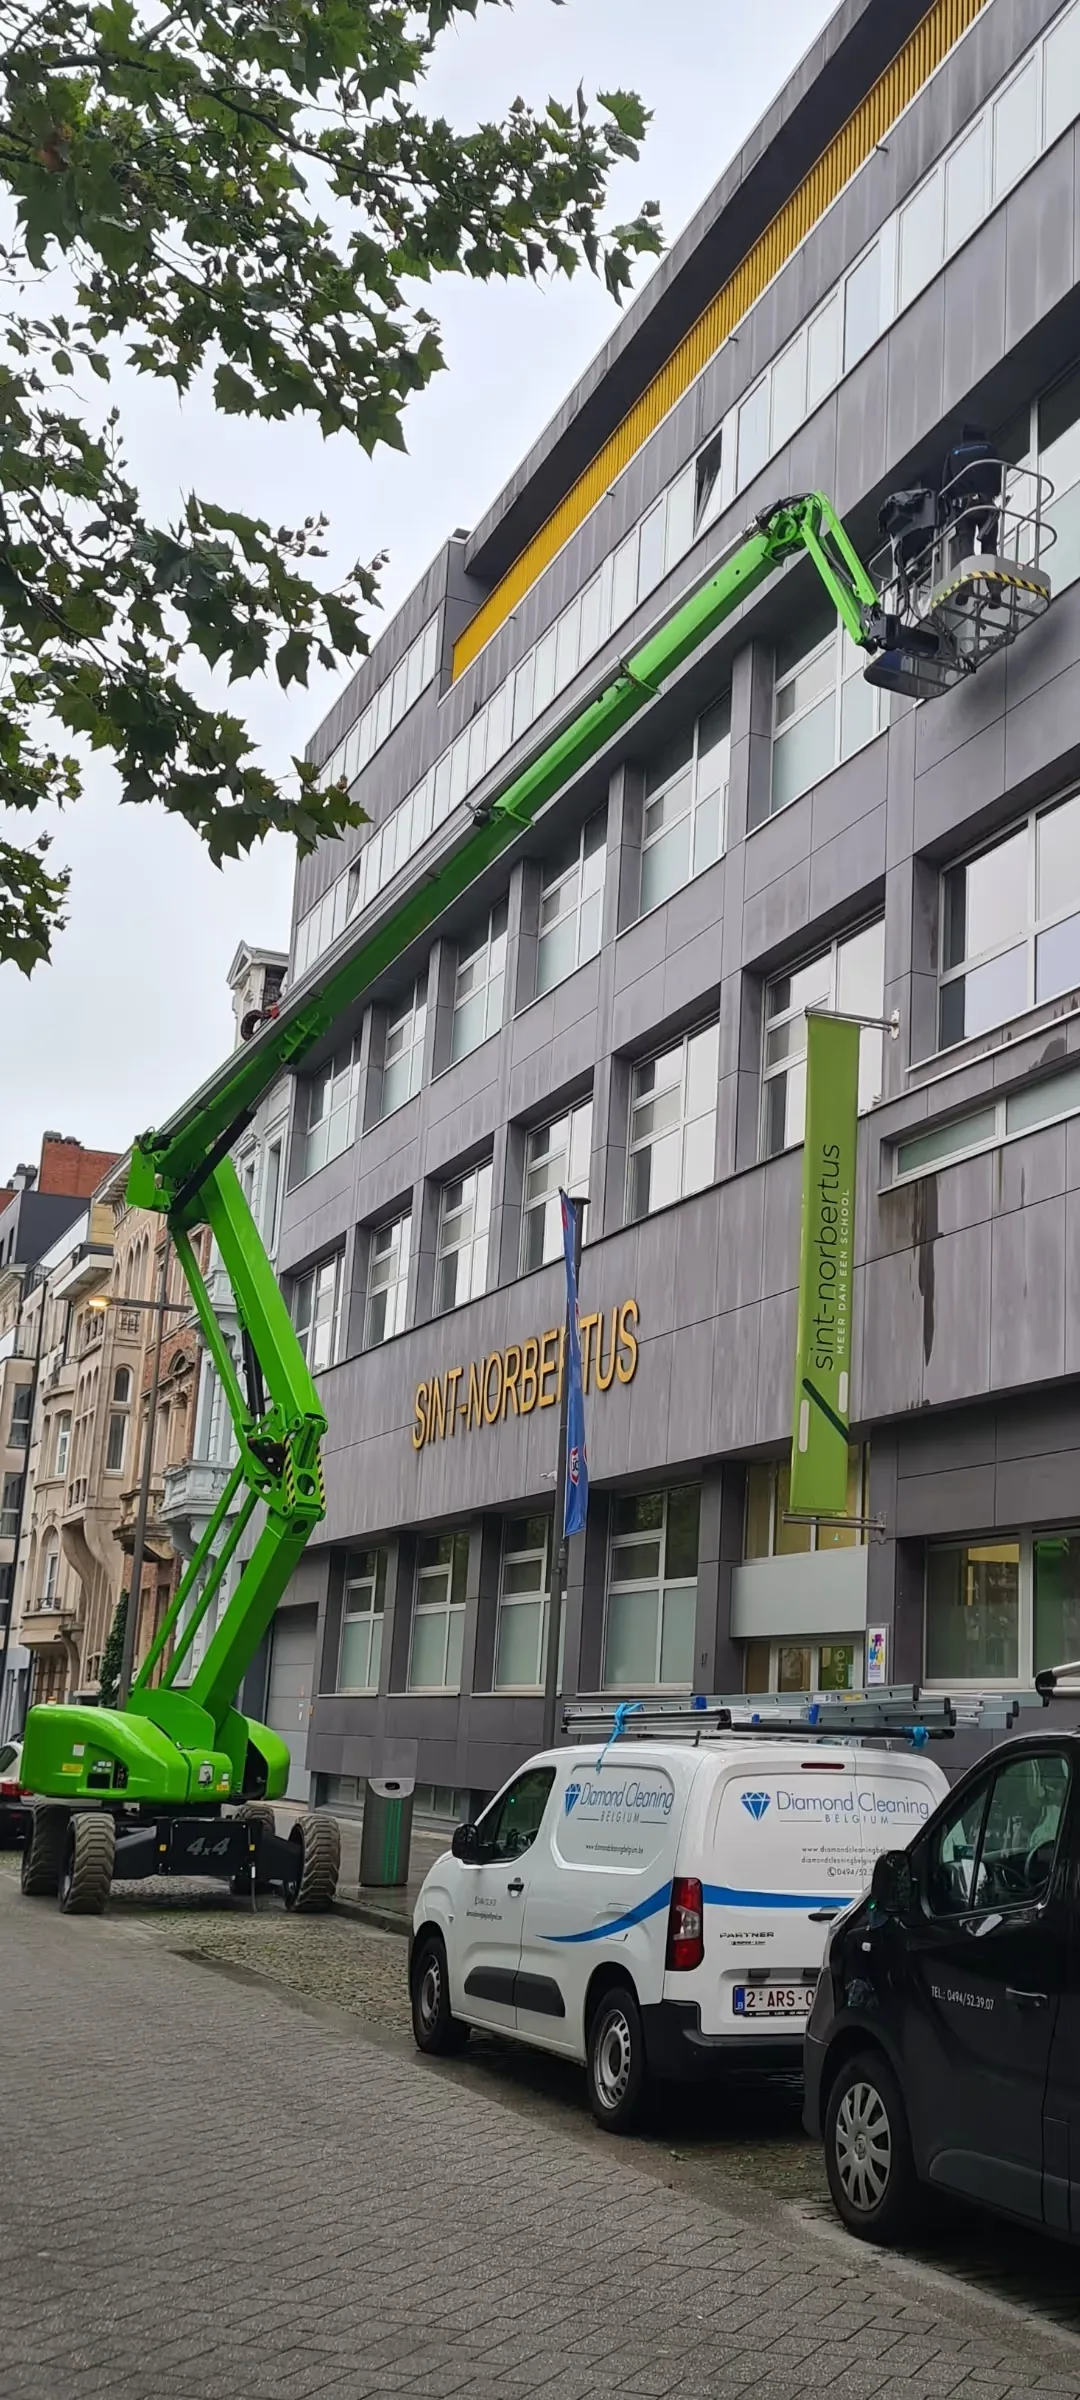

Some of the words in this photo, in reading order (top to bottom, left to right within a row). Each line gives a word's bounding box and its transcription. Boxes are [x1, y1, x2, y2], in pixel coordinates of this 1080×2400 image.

[840, 1189, 850, 1244] SCHOOL
[810, 1144, 840, 1371] sint-norbertus
[839, 1255, 848, 1277] EEN
[838, 1283, 847, 1311] DAN
[837, 1318, 846, 1355] MEER
[580, 1781, 627, 1807] Diamond
[625, 1781, 675, 1816] Cleaning
[776, 1790, 854, 1811] Diamond
[858, 1792, 930, 1820] Cleaning
[600, 1811, 640, 1823] BELGIUM
[825, 1814, 889, 1825] BELGIUM
[186, 1837, 231, 1856] 4x4
[947, 1989, 994, 2010] 0494/52.39.07
